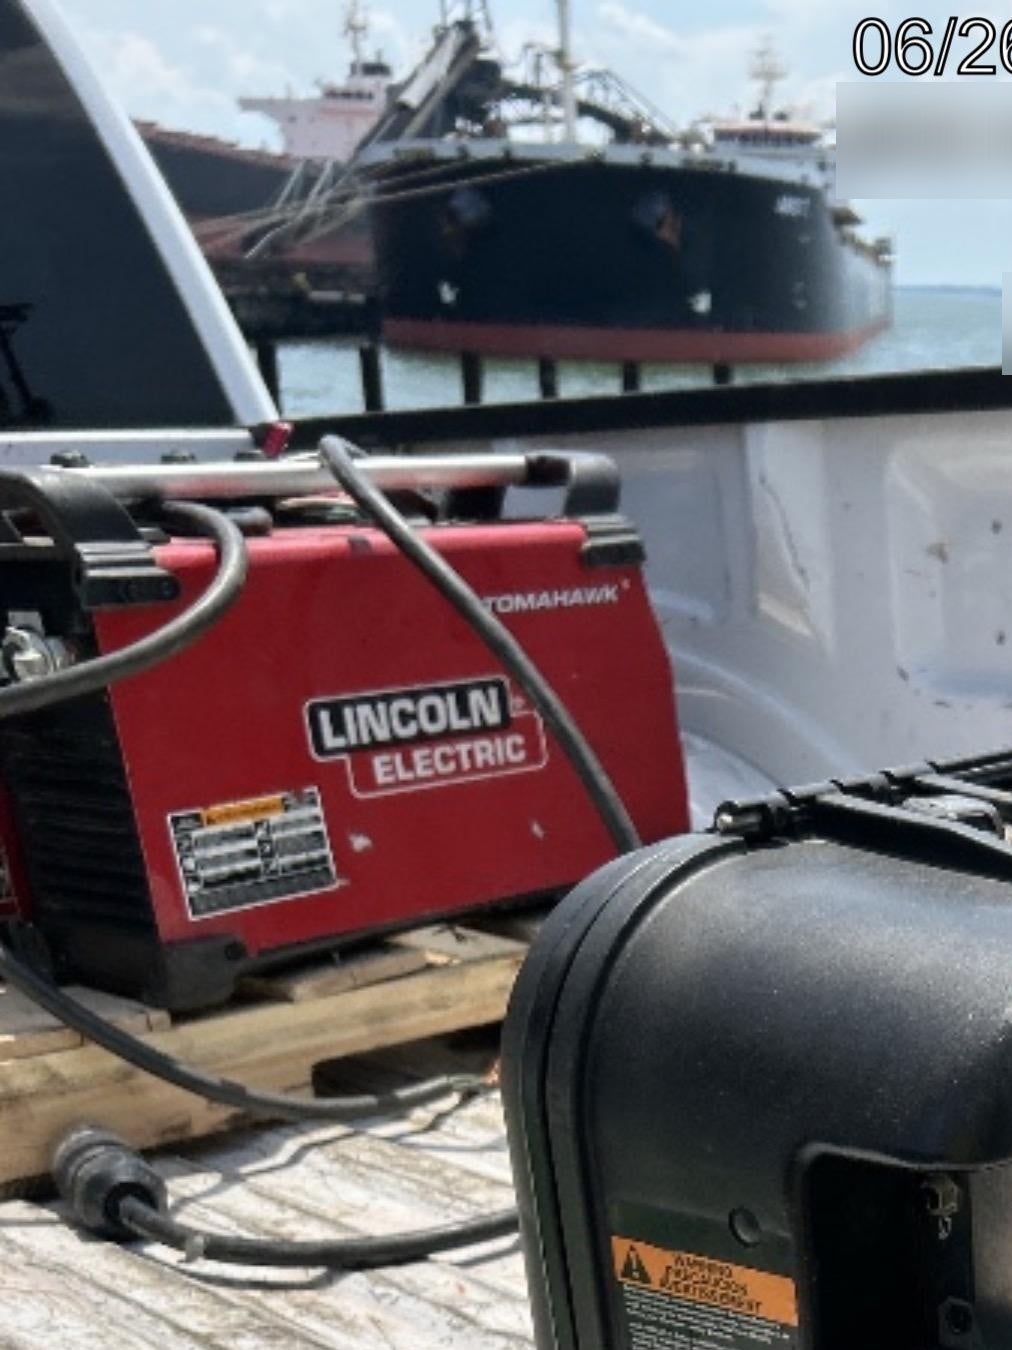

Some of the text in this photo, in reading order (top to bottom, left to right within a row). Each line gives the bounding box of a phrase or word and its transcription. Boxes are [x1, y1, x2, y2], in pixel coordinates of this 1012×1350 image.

[481, 584, 619, 614] TOMAHAWK
[319, 687, 501, 749] LINCOLN
[373, 734, 527, 785] ELECTRIC
